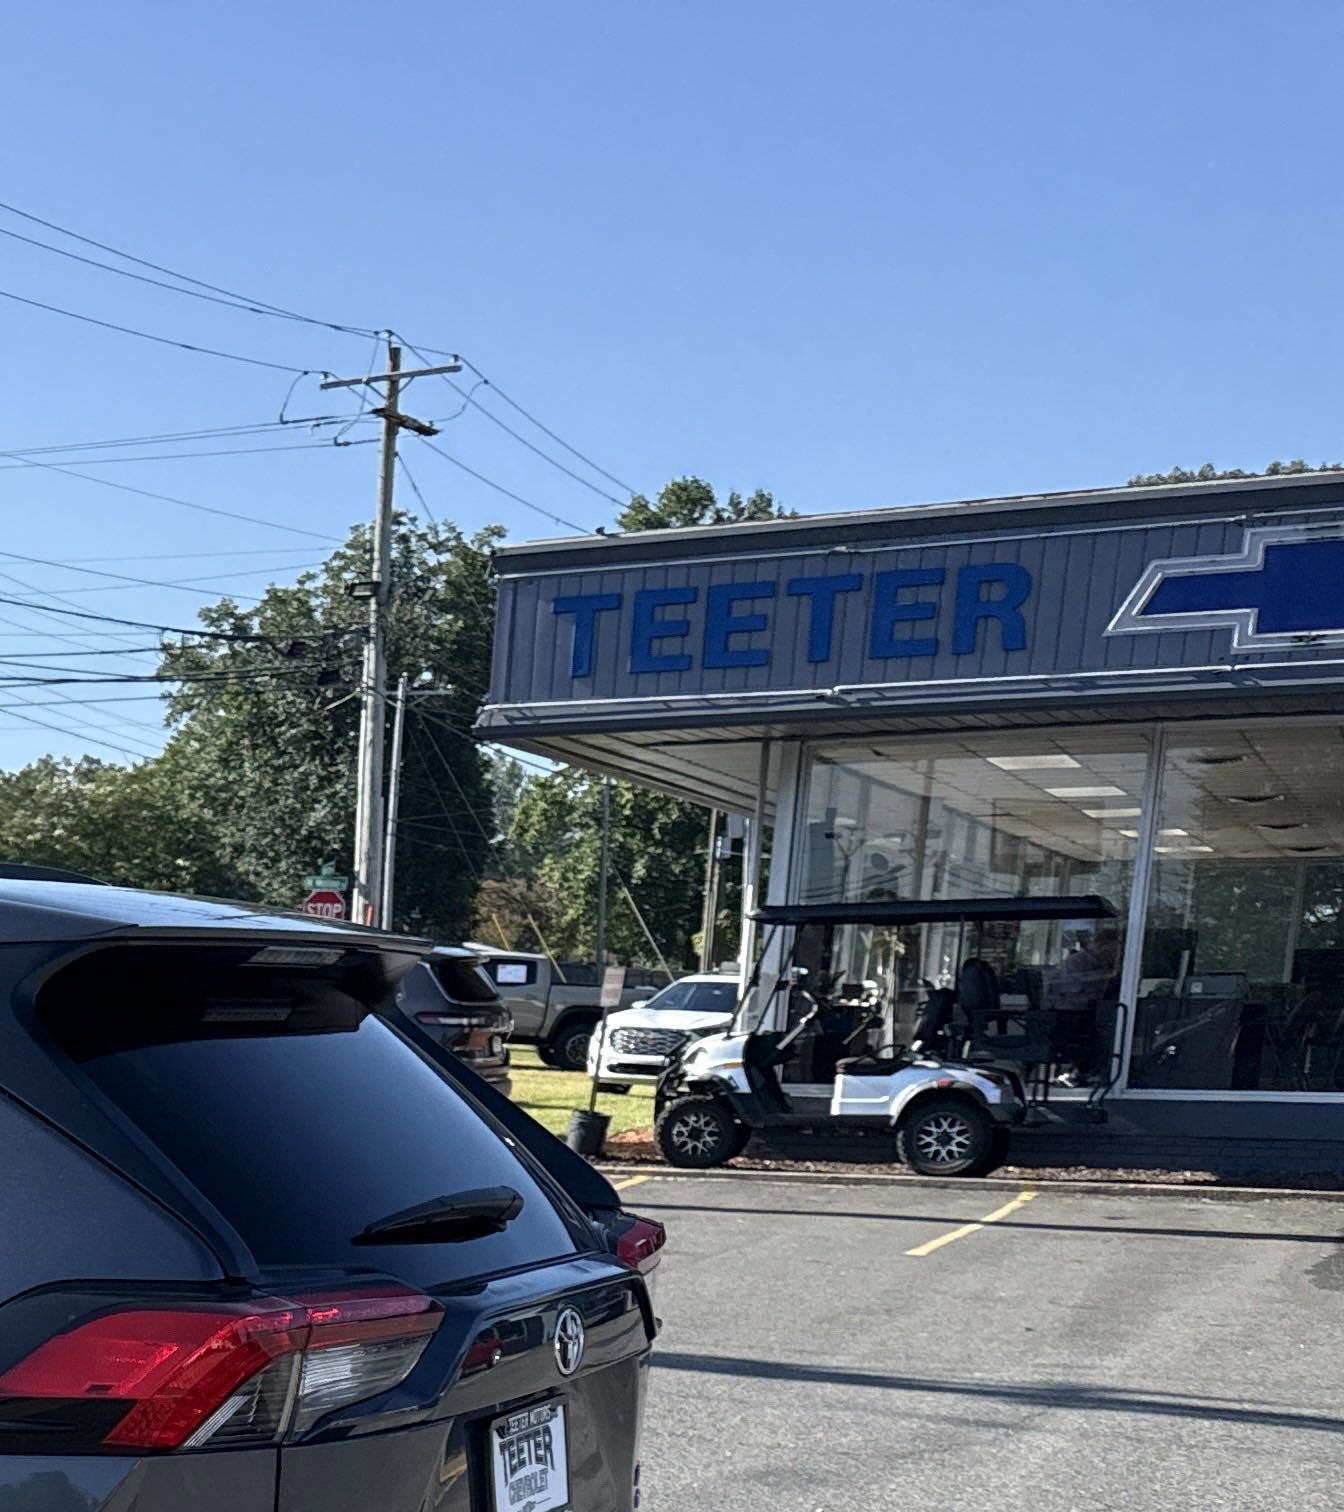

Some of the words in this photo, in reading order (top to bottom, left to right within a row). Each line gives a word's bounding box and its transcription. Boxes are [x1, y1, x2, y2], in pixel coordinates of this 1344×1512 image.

[552, 561, 1033, 679] TEETER
[307, 903, 342, 919] STOP
[499, 1424, 555, 1488] TEETER
